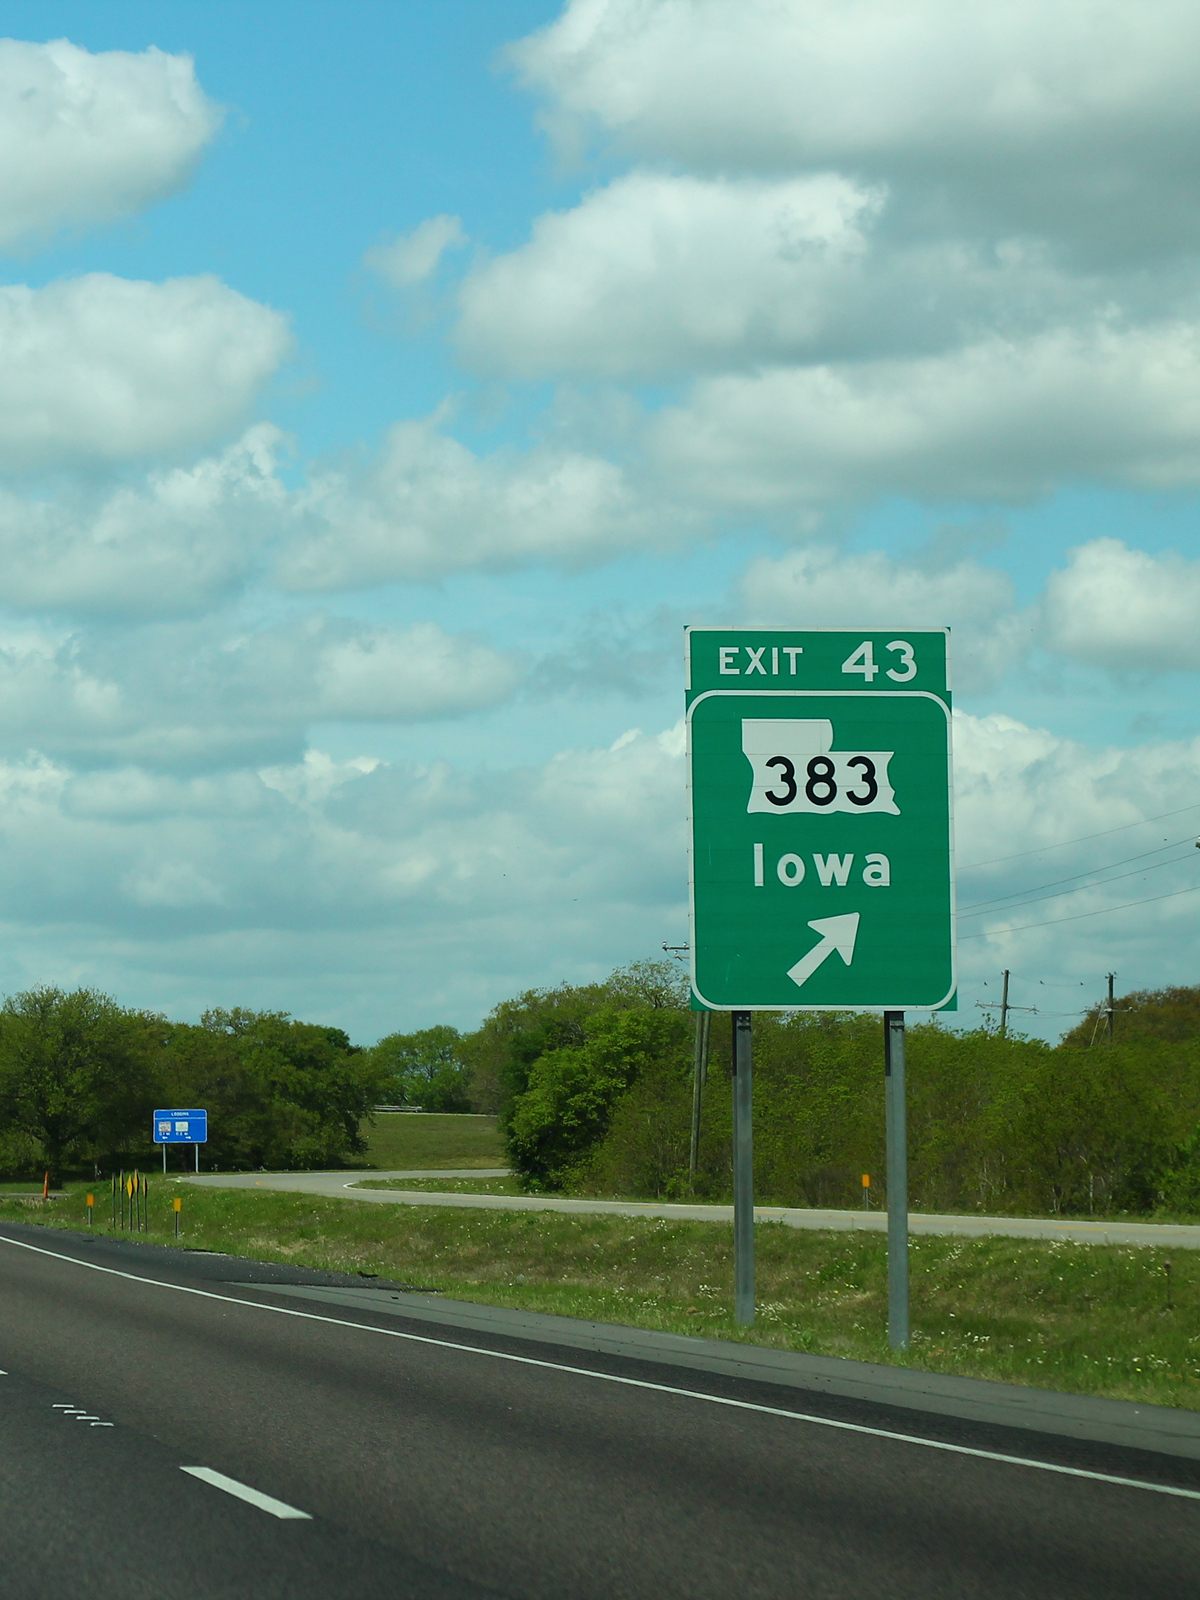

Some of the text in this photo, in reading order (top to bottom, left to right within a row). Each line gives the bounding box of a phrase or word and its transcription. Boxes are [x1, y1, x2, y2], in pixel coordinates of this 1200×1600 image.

[718, 640, 918, 682] EXIT 43
[764, 755, 878, 806] 383
[753, 842, 891, 887] Iowa
